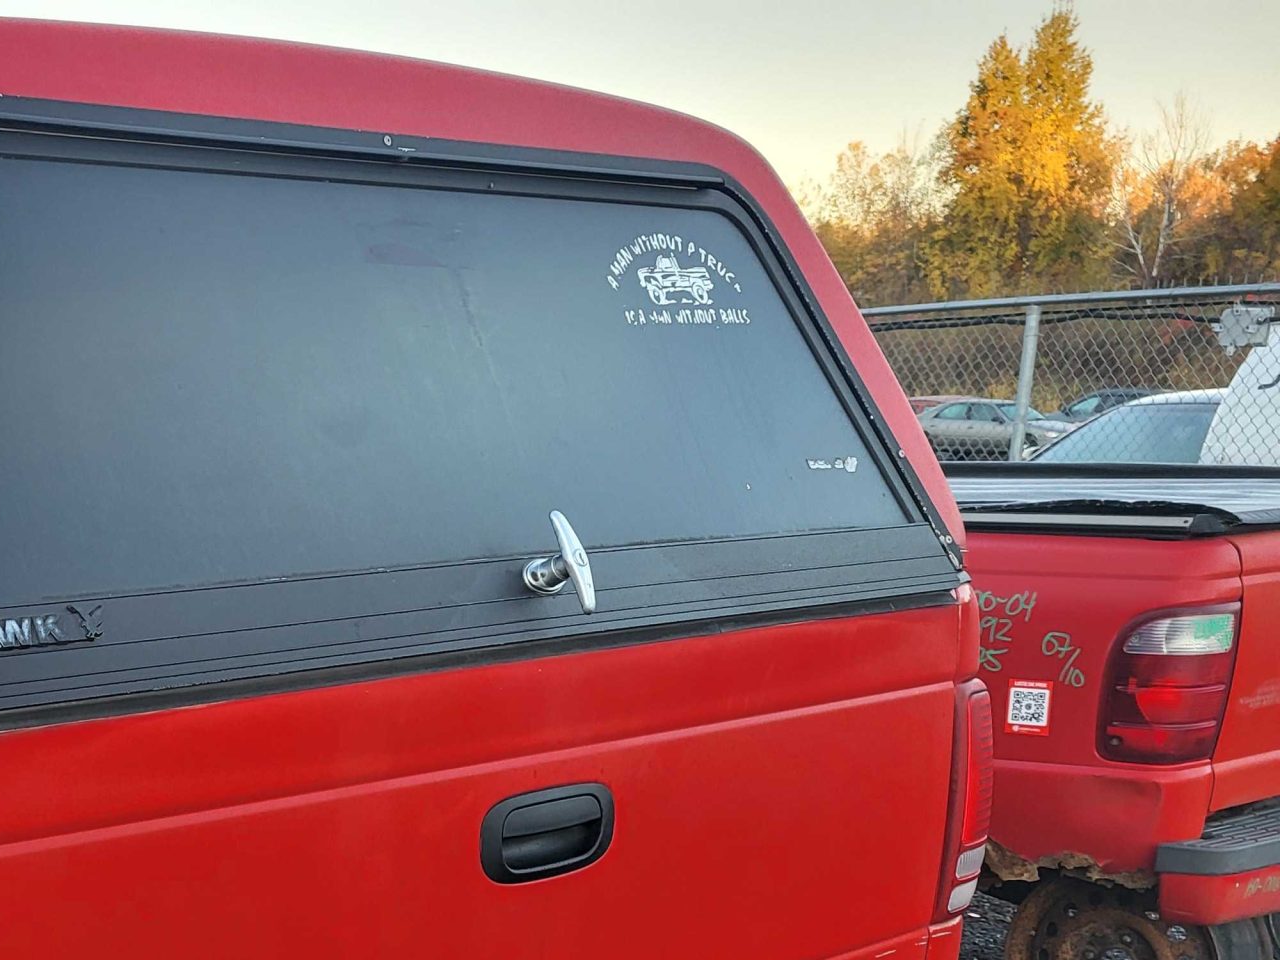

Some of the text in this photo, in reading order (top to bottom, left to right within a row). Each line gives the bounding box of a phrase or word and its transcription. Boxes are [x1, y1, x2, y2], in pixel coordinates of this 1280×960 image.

[630, 233, 682, 255] WITHOUT
[687, 242, 696, 256] A
[719, 308, 751, 325] BALLS
[979, 616, 1013, 643] 92
